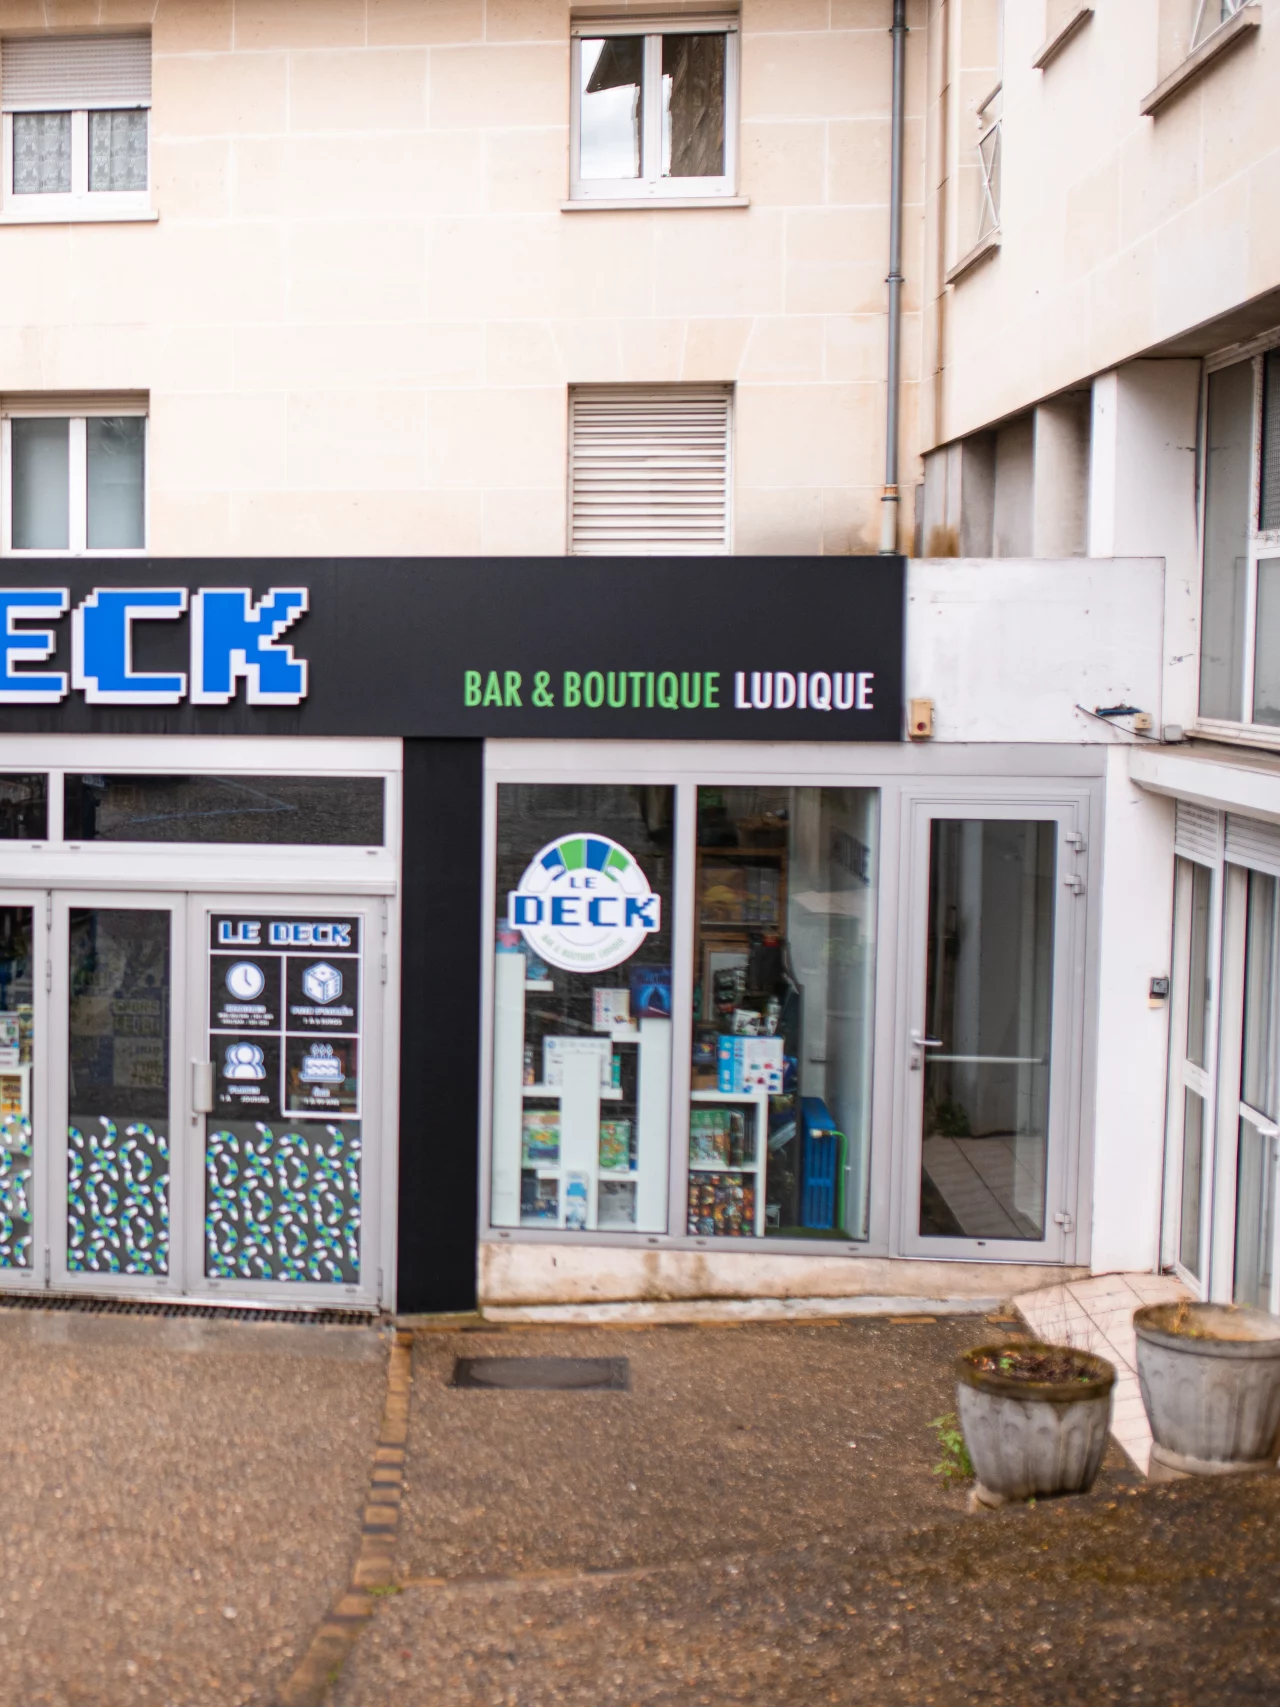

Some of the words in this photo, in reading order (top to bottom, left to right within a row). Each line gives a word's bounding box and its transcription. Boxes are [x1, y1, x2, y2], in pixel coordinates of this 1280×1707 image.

[464, 670, 523, 707] BAR
[531, 670, 555, 708] &
[563, 670, 720, 710] BOUTIQUE
[734, 671, 875, 711] LUDIQUE
[570, 877, 597, 888] LE
[514, 895, 656, 927] DECK
[218, 920, 262, 945] LE
[268, 921, 352, 947] DECK
